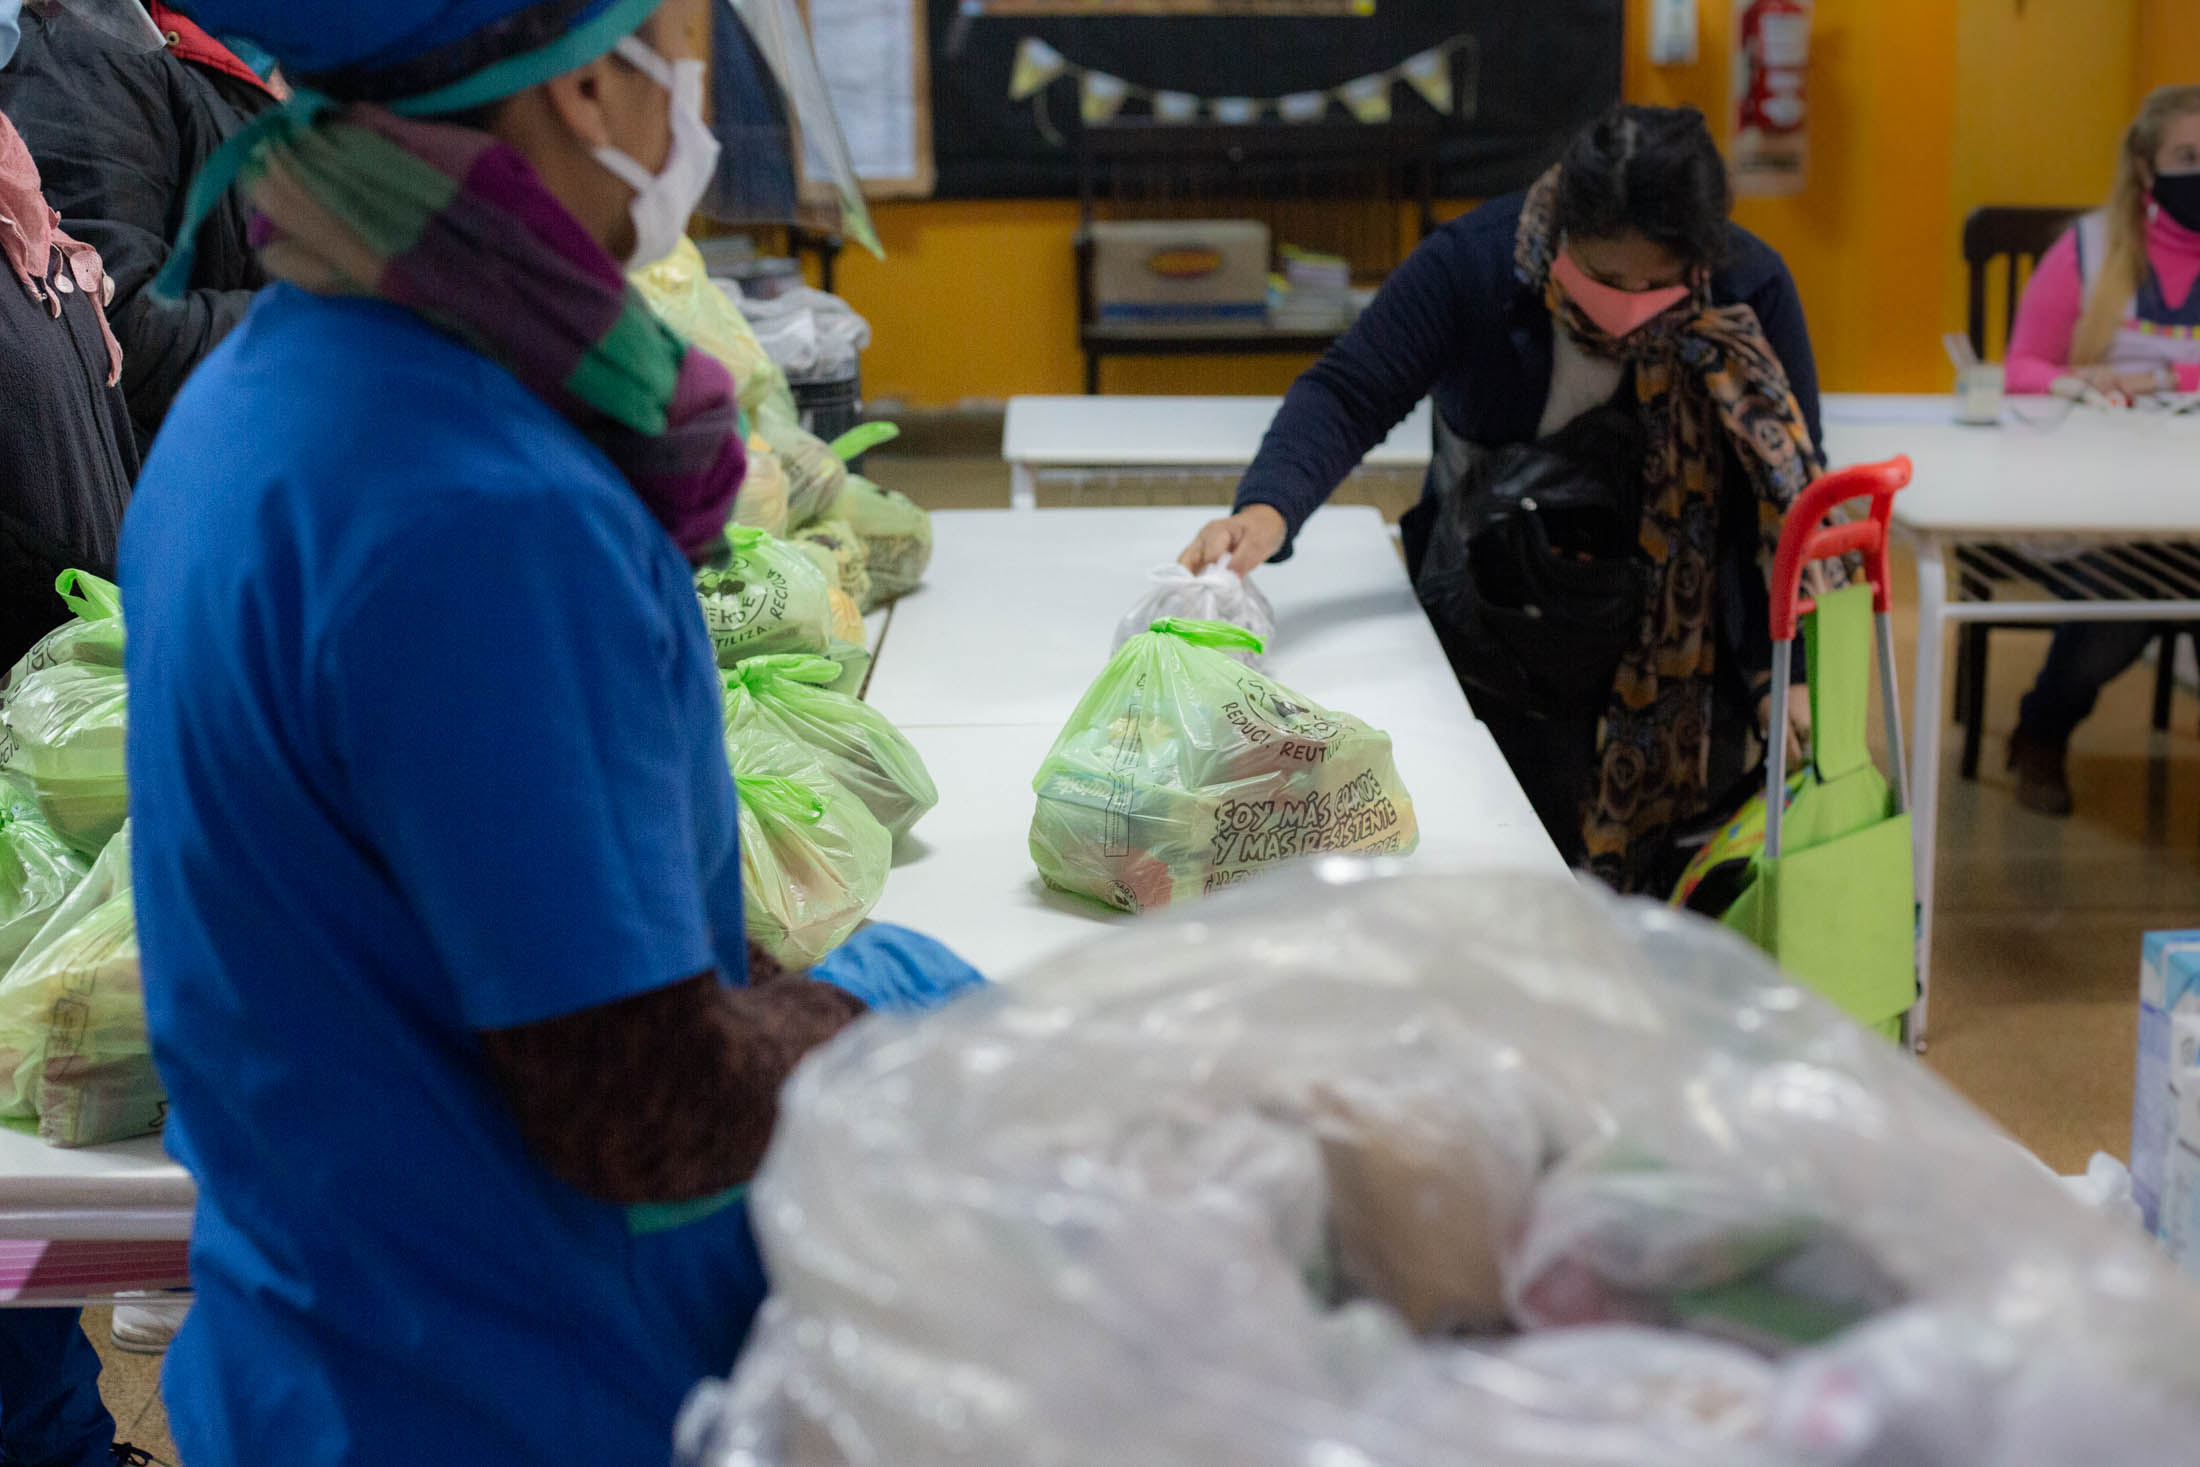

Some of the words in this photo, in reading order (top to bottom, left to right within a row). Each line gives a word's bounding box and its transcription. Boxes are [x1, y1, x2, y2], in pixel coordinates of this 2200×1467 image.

[1211, 831, 1240, 866] Y
[1239, 826, 1297, 862] MÁS
[1302, 796, 1397, 856] RESISTENTE
[1215, 799, 1275, 833] SOY
[1276, 790, 1331, 829] MÁS
[1333, 768, 1382, 820] GRANDE
